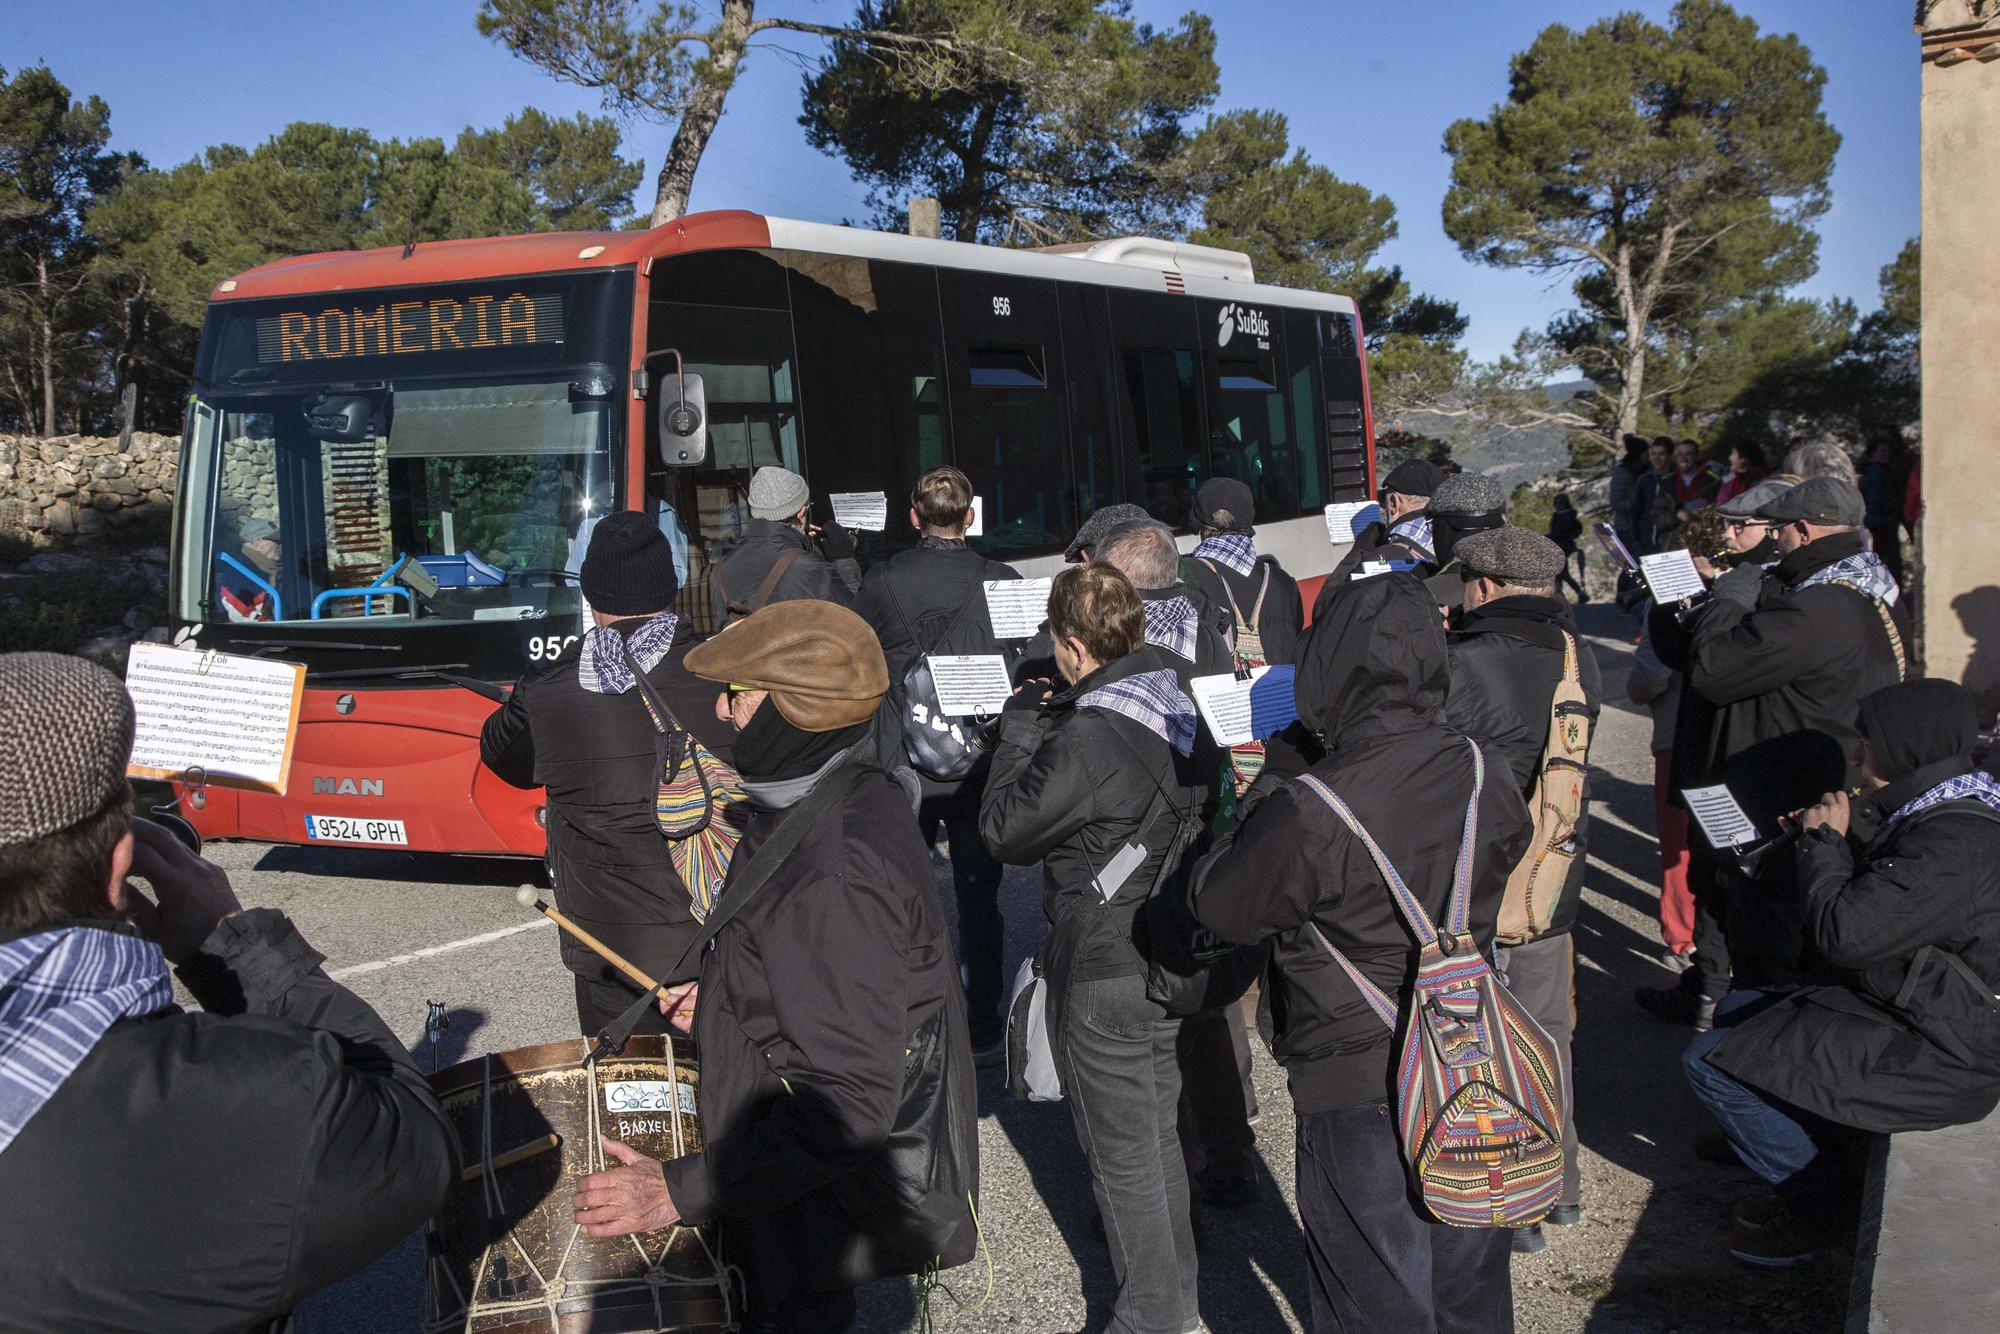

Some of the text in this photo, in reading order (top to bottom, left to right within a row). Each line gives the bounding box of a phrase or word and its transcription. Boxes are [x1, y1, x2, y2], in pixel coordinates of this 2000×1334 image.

[993, 296, 1010, 316] 956
[280, 292, 536, 361] ROMERIA
[1237, 306, 1269, 337] SuBús
[313, 776, 384, 797] MAN
[319, 819, 401, 842] 9524 GPH
